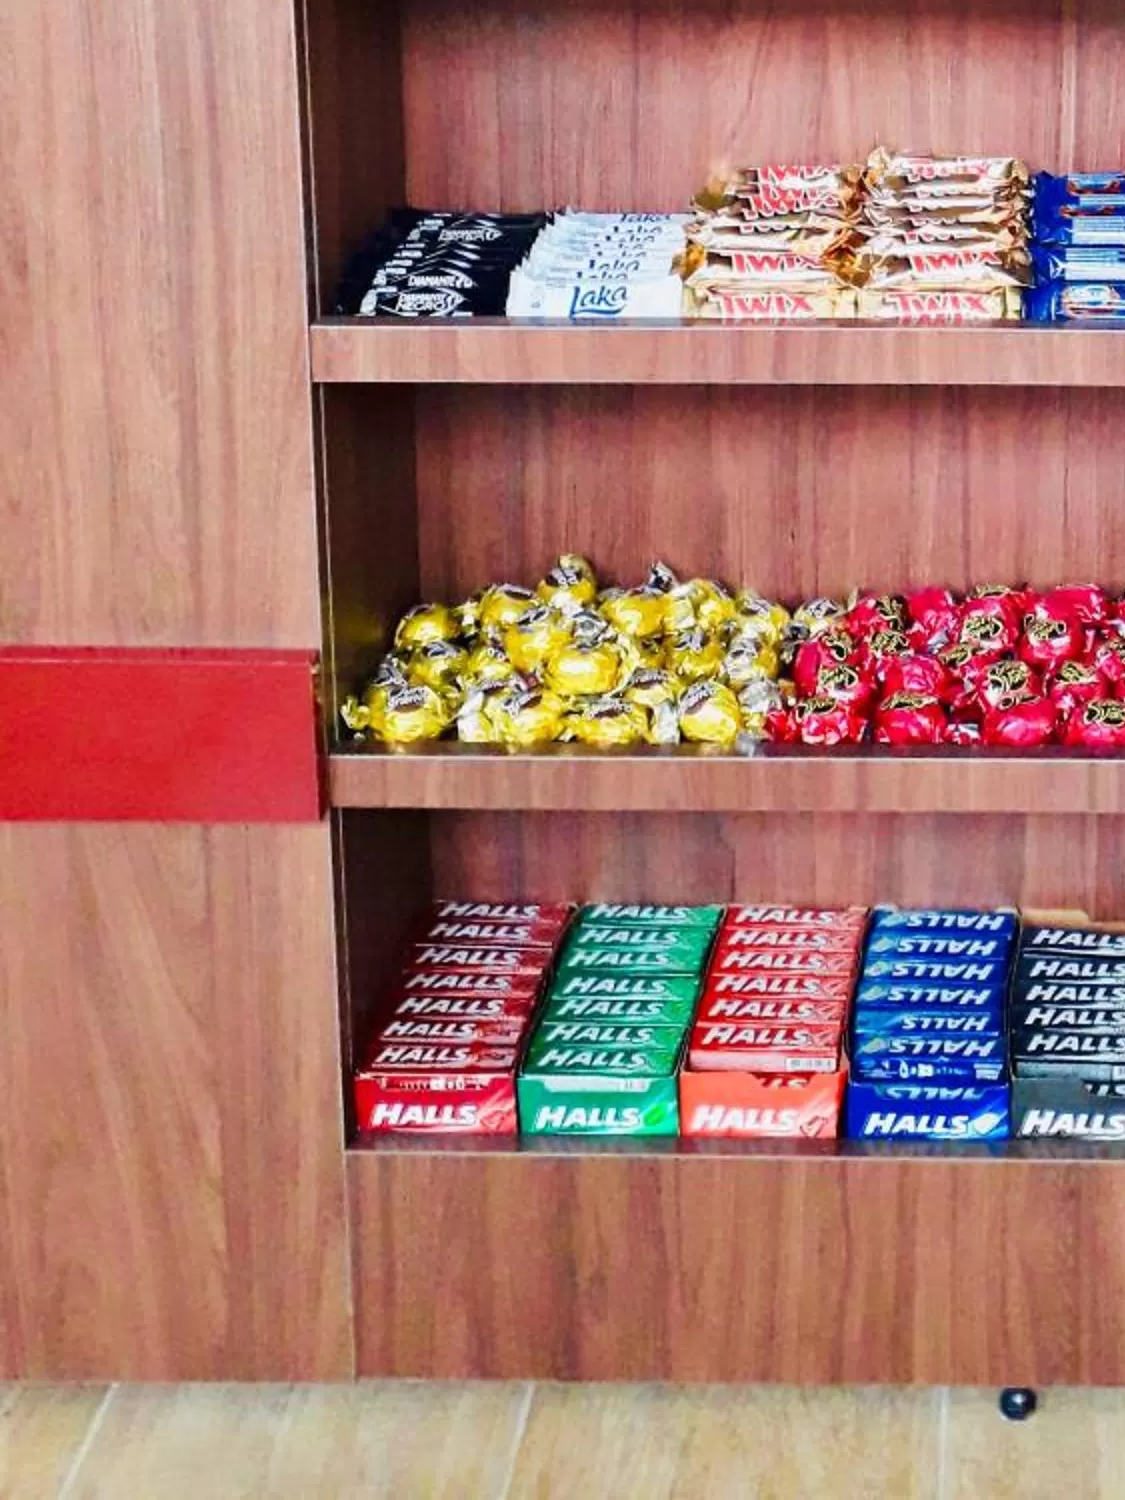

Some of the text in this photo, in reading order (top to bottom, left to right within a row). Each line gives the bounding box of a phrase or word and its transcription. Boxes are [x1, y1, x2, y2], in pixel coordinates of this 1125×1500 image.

[729, 251, 824, 275] TWIX
[908, 250, 1002, 274] TWIX
[569, 285, 628, 322] Laka
[711, 292, 814, 316] TWIX
[888, 292, 992, 316] TWIX
[438, 903, 540, 920] HALLS
[590, 903, 690, 920] HALLS
[736, 907, 836, 925] HALLS
[428, 923, 531, 940] HALLS
[906, 915, 1004, 931] HALLS
[578, 927, 680, 944] HALLS
[728, 930, 829, 948] HALLS
[898, 938, 997, 956] HALLS
[416, 949, 521, 965] HALLS
[568, 950, 672, 967] HALLS
[721, 952, 824, 970] HALLS
[893, 963, 995, 981] HALLS
[405, 974, 512, 990] HALLS
[564, 977, 667, 994] HALLS
[716, 975, 820, 994] HALLS
[888, 988, 991, 1005] HALLS
[396, 998, 504, 1014] HALLS
[558, 1000, 663, 1016] HALLS
[708, 1000, 815, 1018] HALLS
[384, 1021, 476, 1038] HALLS
[902, 1015, 989, 1032] HALLS
[546, 1025, 653, 1043] HALLS
[701, 1025, 811, 1045] HALLS
[375, 1046, 469, 1063] HALLS
[889, 1040, 997, 1057] HALLS
[538, 1050, 647, 1067] HALLS
[370, 1103, 478, 1127] HALLS
[535, 1105, 641, 1130] HALLS
[692, 1107, 798, 1131] HALLS
[864, 1113, 970, 1134] HALLS
